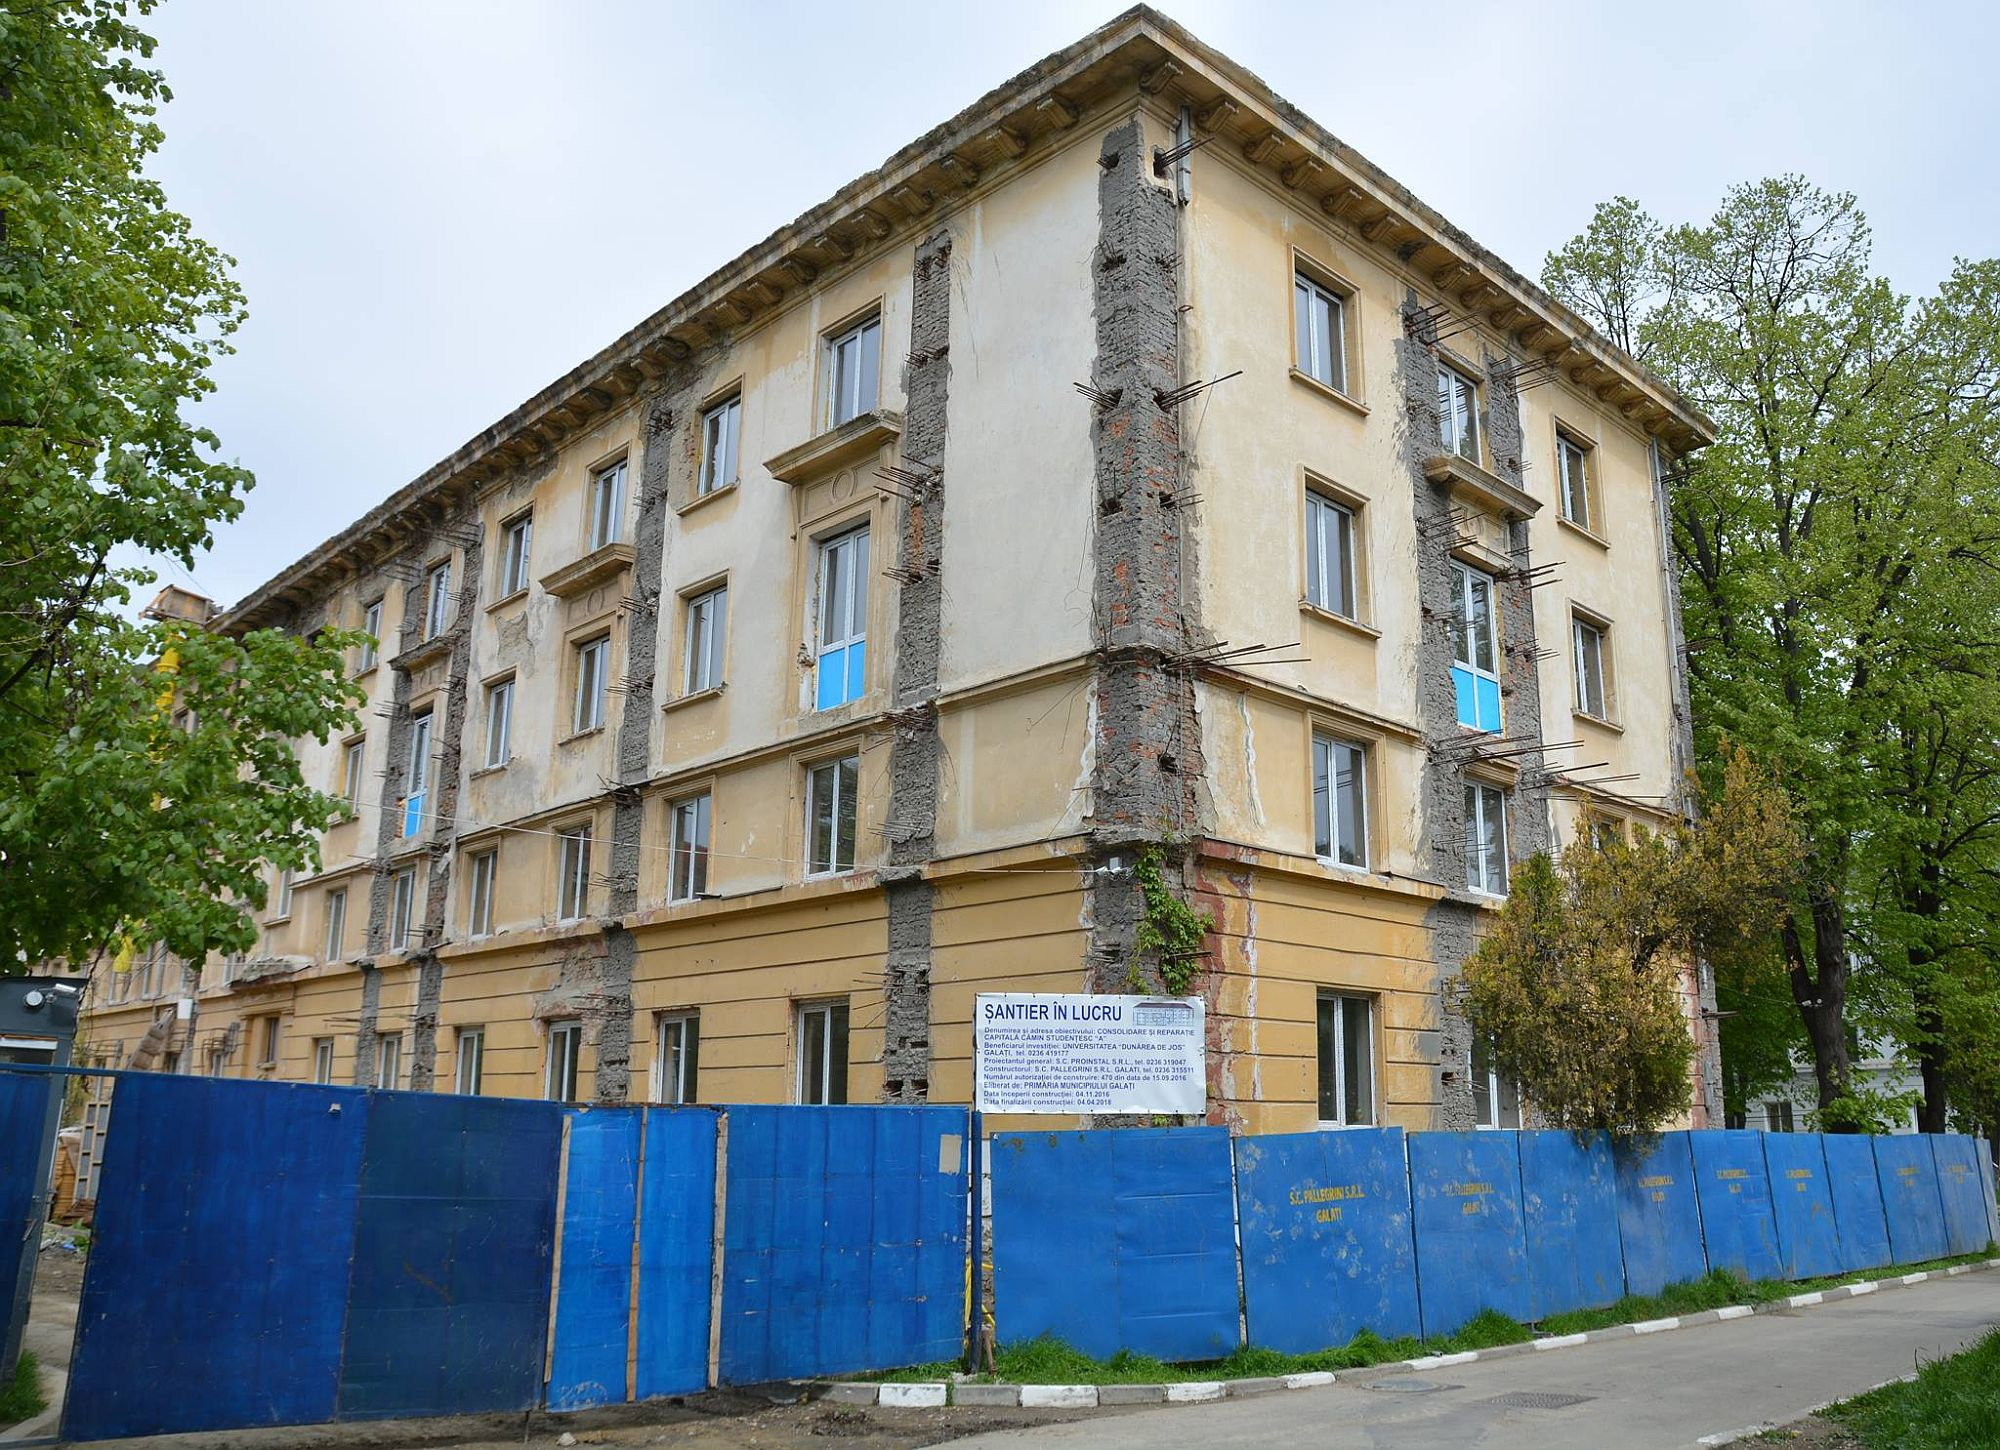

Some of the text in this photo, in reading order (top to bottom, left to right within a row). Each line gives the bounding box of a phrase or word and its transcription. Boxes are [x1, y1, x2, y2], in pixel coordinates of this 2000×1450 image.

[985, 1001, 1122, 1024] ȘANTIER ÎN LUCRU
